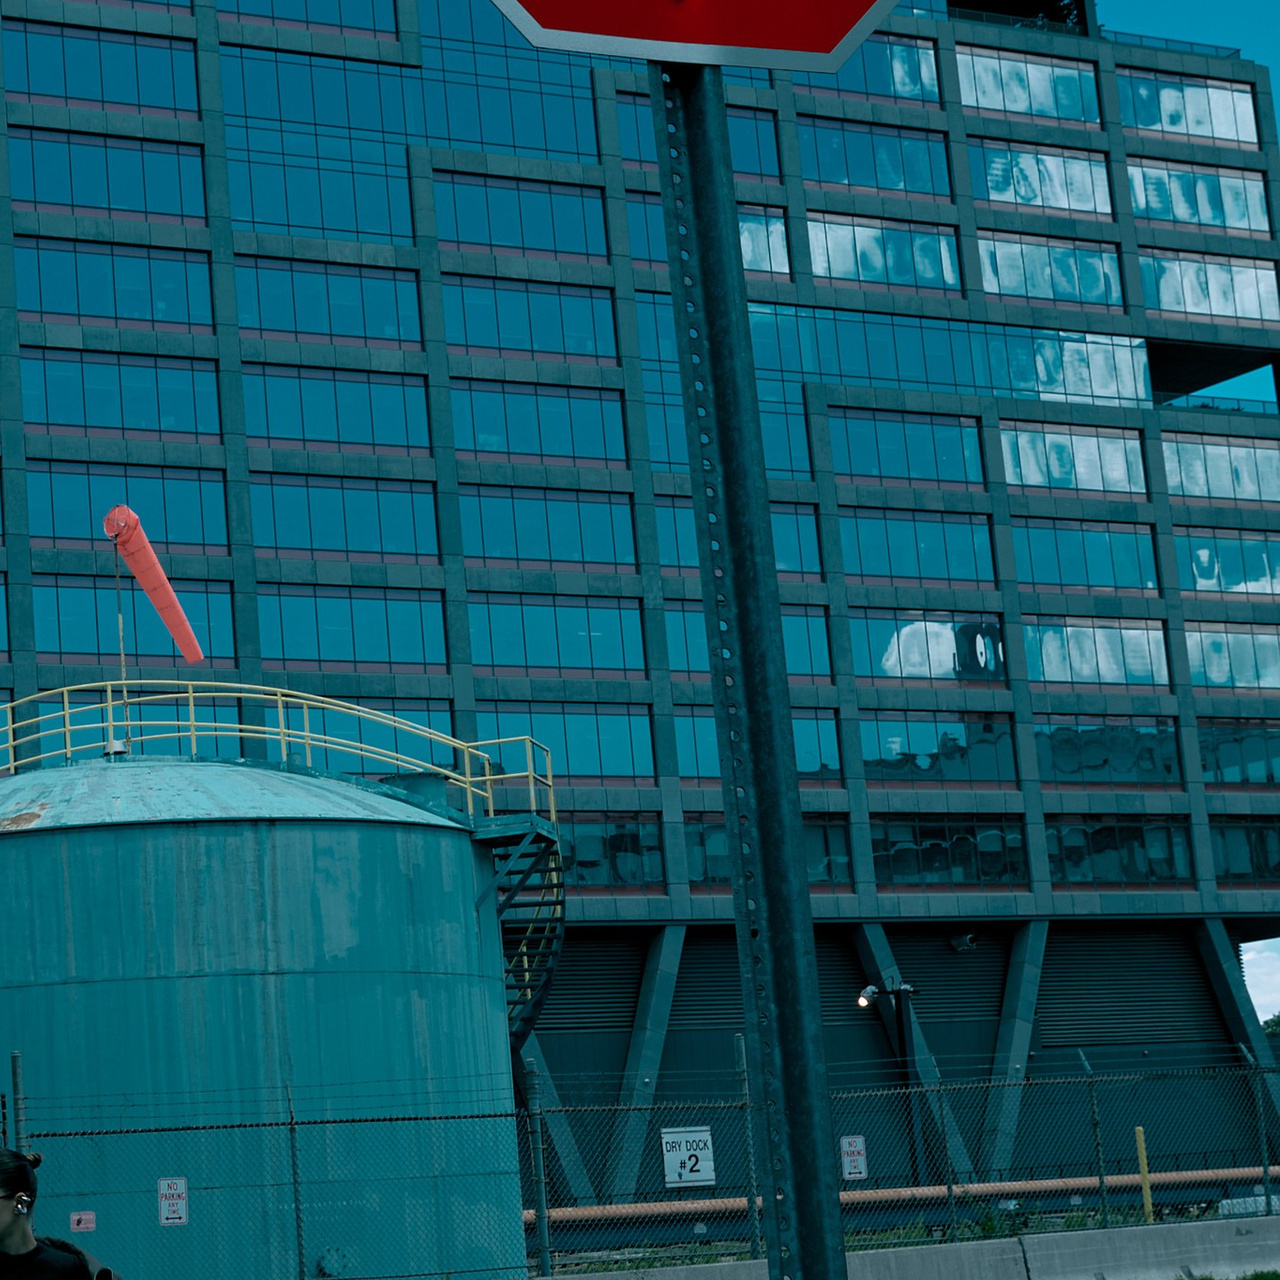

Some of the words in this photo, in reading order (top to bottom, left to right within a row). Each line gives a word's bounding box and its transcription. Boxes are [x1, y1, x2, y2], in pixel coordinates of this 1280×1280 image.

[665, 1140, 682, 1152] DRY
[685, 1139, 709, 1152] DOCK
[848, 1140, 858, 1148] NO
[679, 1154, 701, 1173] #2
[167, 1182, 178, 1191] NO
[160, 1193, 185, 1201] PARKING
